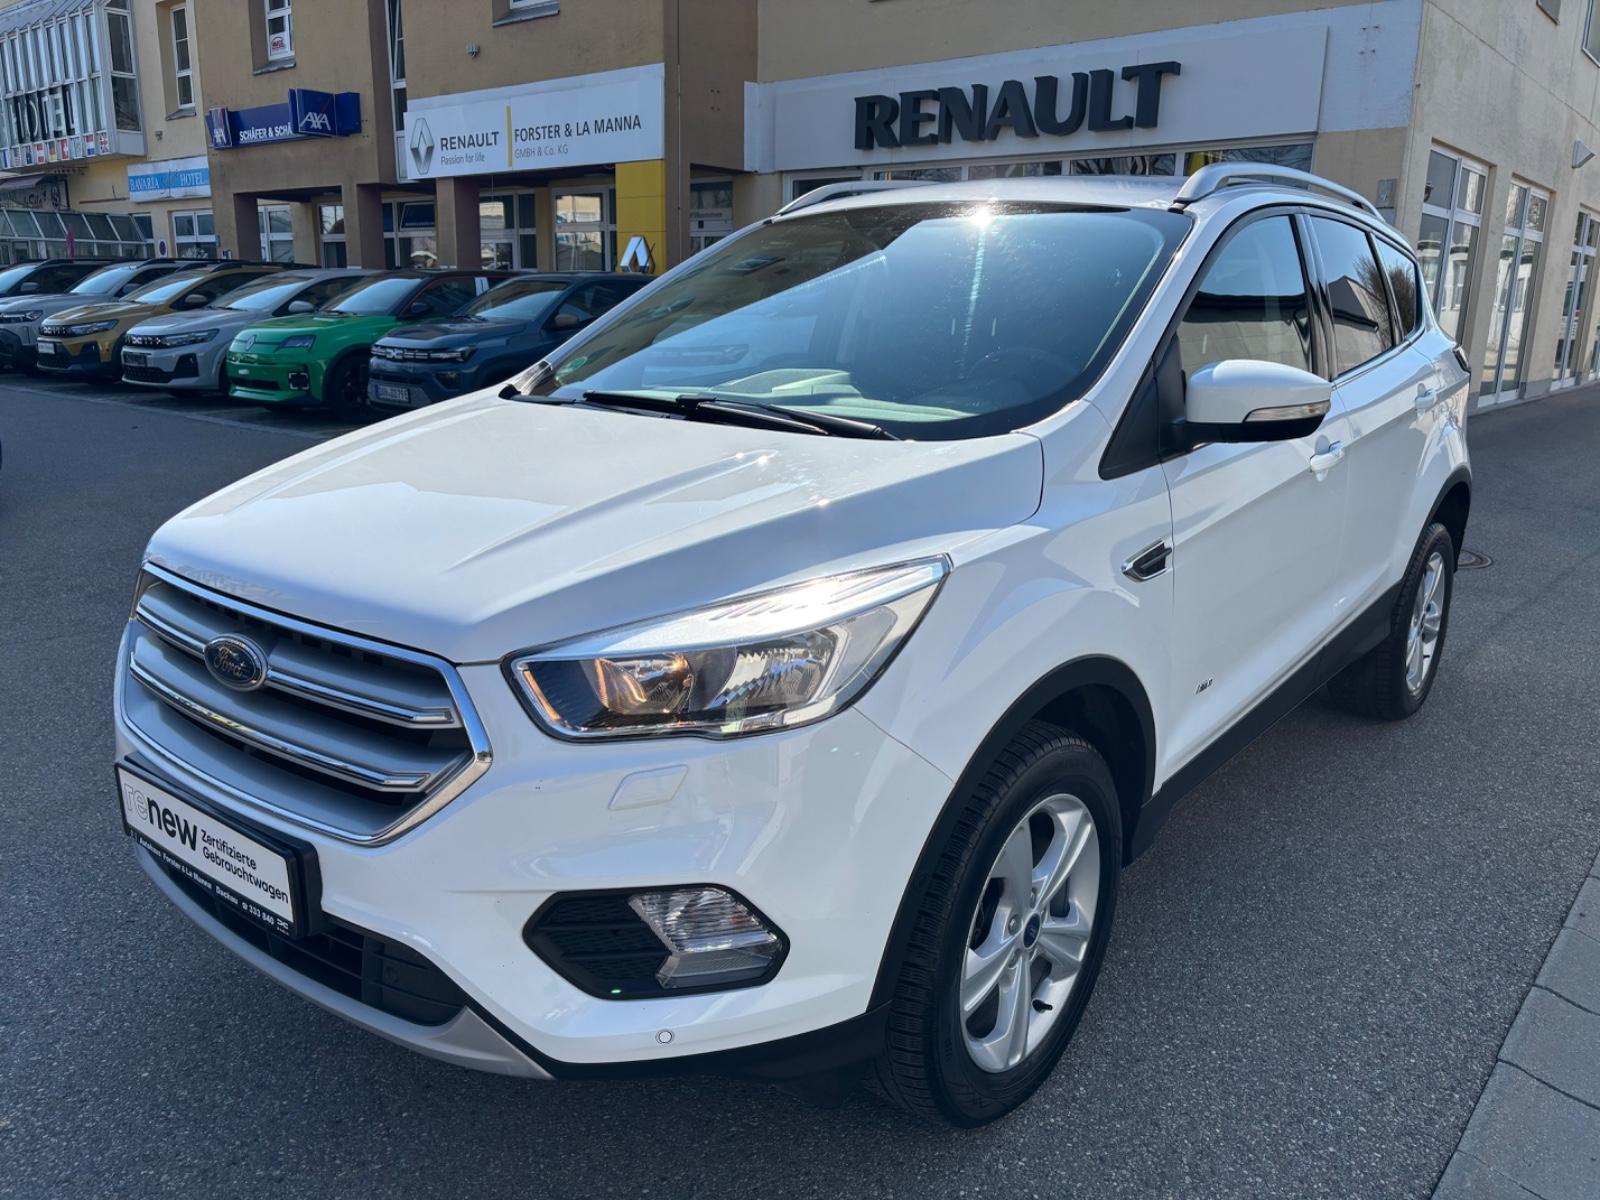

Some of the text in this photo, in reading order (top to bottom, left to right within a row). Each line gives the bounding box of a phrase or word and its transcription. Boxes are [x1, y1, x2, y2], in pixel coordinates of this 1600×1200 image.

[854, 61, 1182, 152] RENAULT
[299, 112, 332, 131] AXA
[514, 115, 642, 142] FORSTER & LA MANNA
[239, 126, 266, 142] SCHÄFER
[268, 125, 274, 138] &
[440, 131, 499, 151] RENAULT
[440, 152, 485, 166] Passion for life
[537, 146, 542, 157] &
[557, 144, 569, 154] KG
[129, 171, 205, 191] BAVARIA HOTEL
[124, 784, 198, 851] renew
[201, 829, 257, 870] Zertifizierte
[202, 847, 289, 904] Gebrauchtwagen
